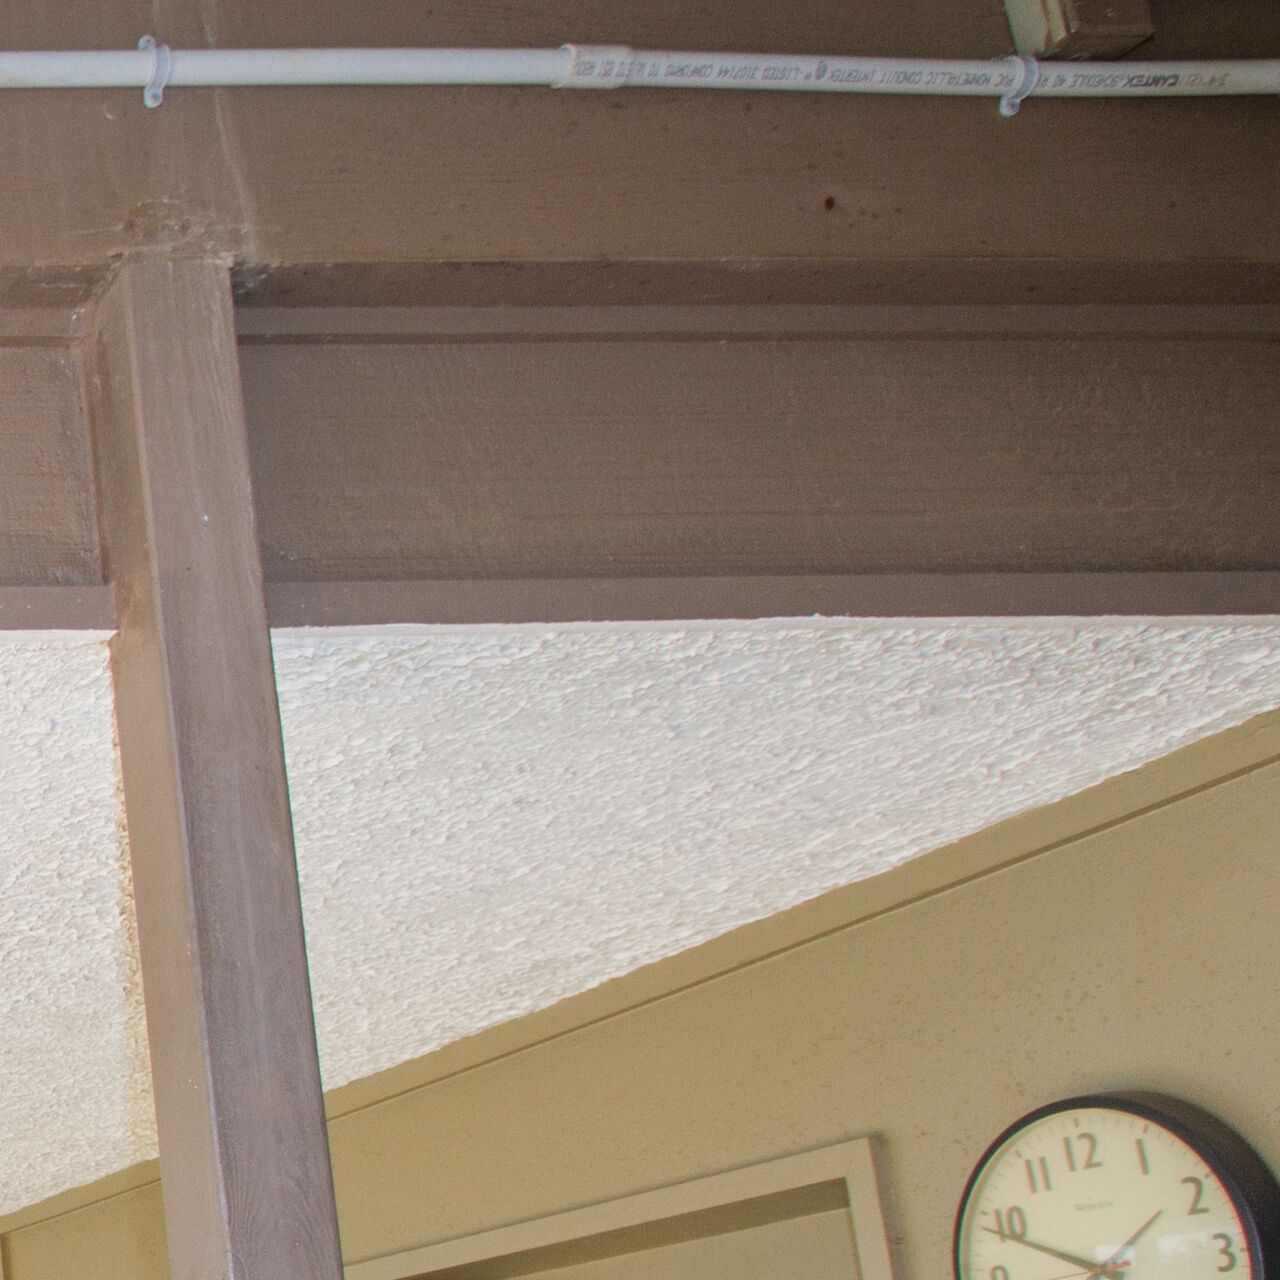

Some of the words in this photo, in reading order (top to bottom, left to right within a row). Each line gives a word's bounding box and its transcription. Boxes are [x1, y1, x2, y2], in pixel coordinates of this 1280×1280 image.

[1069, 73, 1122, 88] SCHEDULE
[1122, 74, 1180, 88] CANTEX
[1063, 1133, 1101, 1172] 12
[1135, 1138, 1149, 1175] 1
[1025, 1156, 1051, 1194] 11
[1181, 1176, 1209, 1215] 2
[995, 1206, 1027, 1241] 10
[1211, 1233, 1236, 1272] 3
